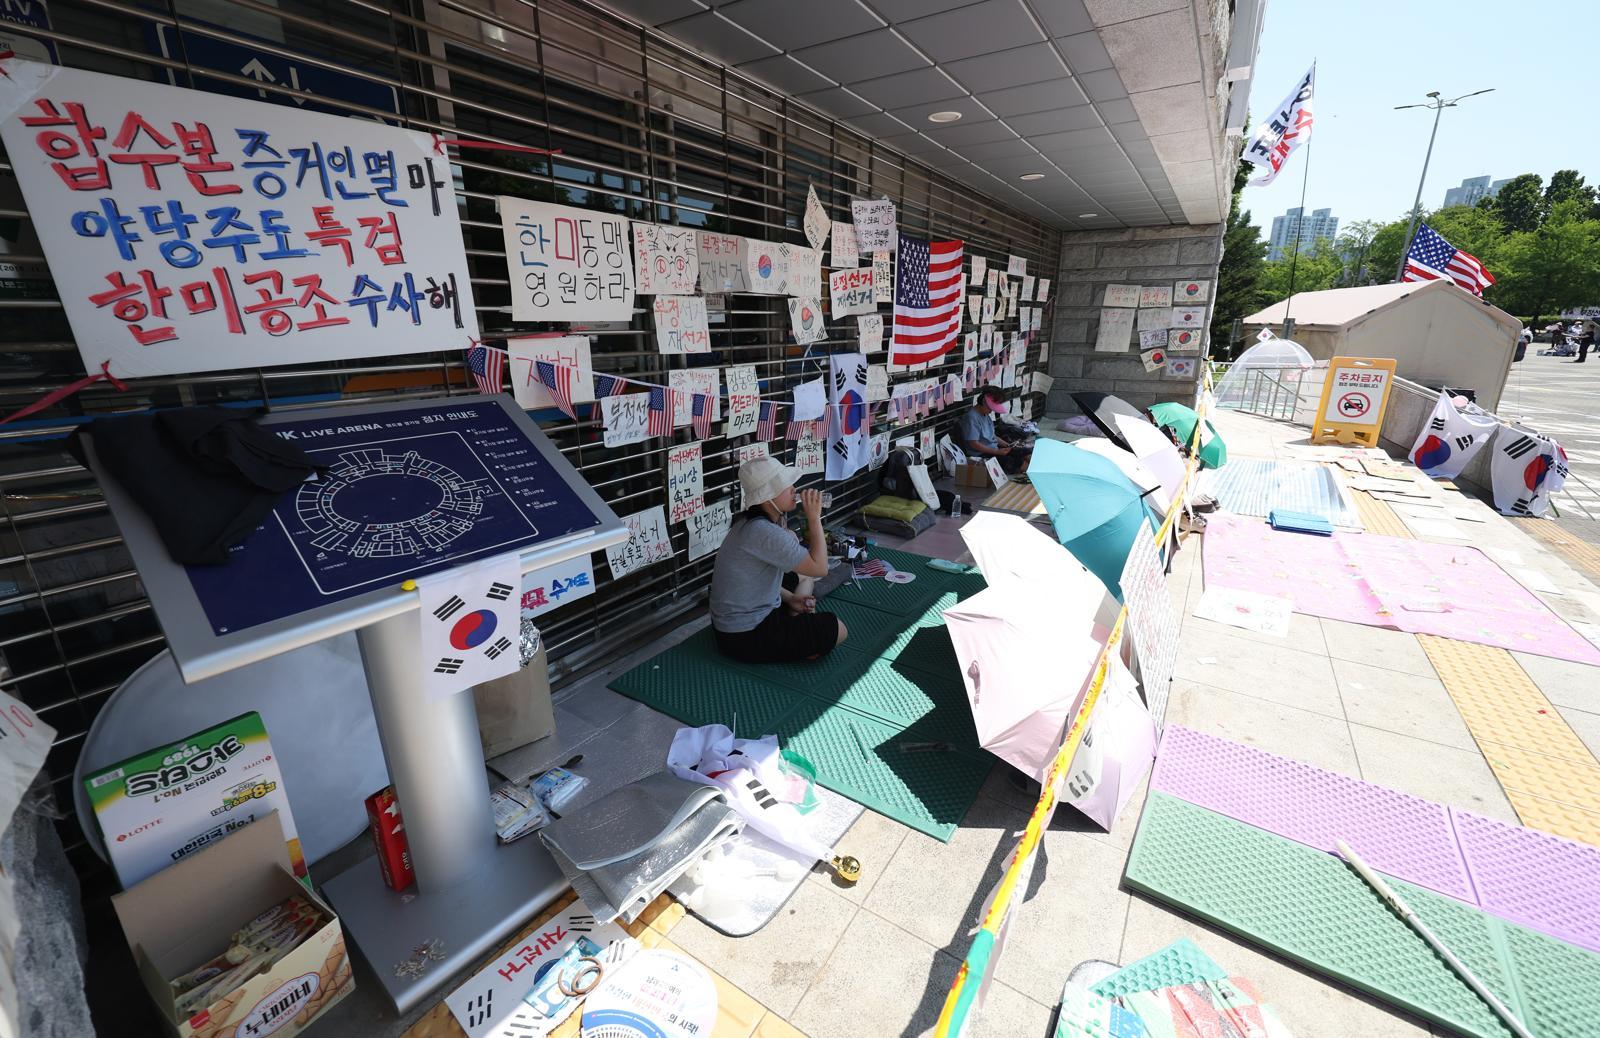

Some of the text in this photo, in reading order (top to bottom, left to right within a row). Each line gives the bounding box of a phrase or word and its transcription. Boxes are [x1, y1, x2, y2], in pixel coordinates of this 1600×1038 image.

[18, 98, 243, 195] 합수본
[71, 197, 407, 269] 야당주도 특검
[515, 215, 624, 268] 한미동맹
[525, 271, 631, 307] 영원하라
[832, 270, 873, 290] 부정선거
[88, 266, 464, 346] 한미공조 수사해
[837, 288, 873, 309] 재선거
[667, 329, 709, 353] 재선거
[1339, 372, 1383, 383] 주차금지
[302, 425, 336, 439] LIVE
[337, 421, 383, 436] ARENA
[421, 414, 445, 424] 점자
[446, 410, 479, 421] 안내도
[608, 399, 650, 430] 부정선
[733, 410, 755, 431] 마라
[797, 453, 820, 470] 아니다
[126, 734, 245, 797] 카스타드
[153, 766, 227, 803] 대한민국 No.1
[128, 817, 164, 837] LOTTE
[170, 814, 256, 861] 대한민국 No.1
[497, 925, 568, 982] 재선거
